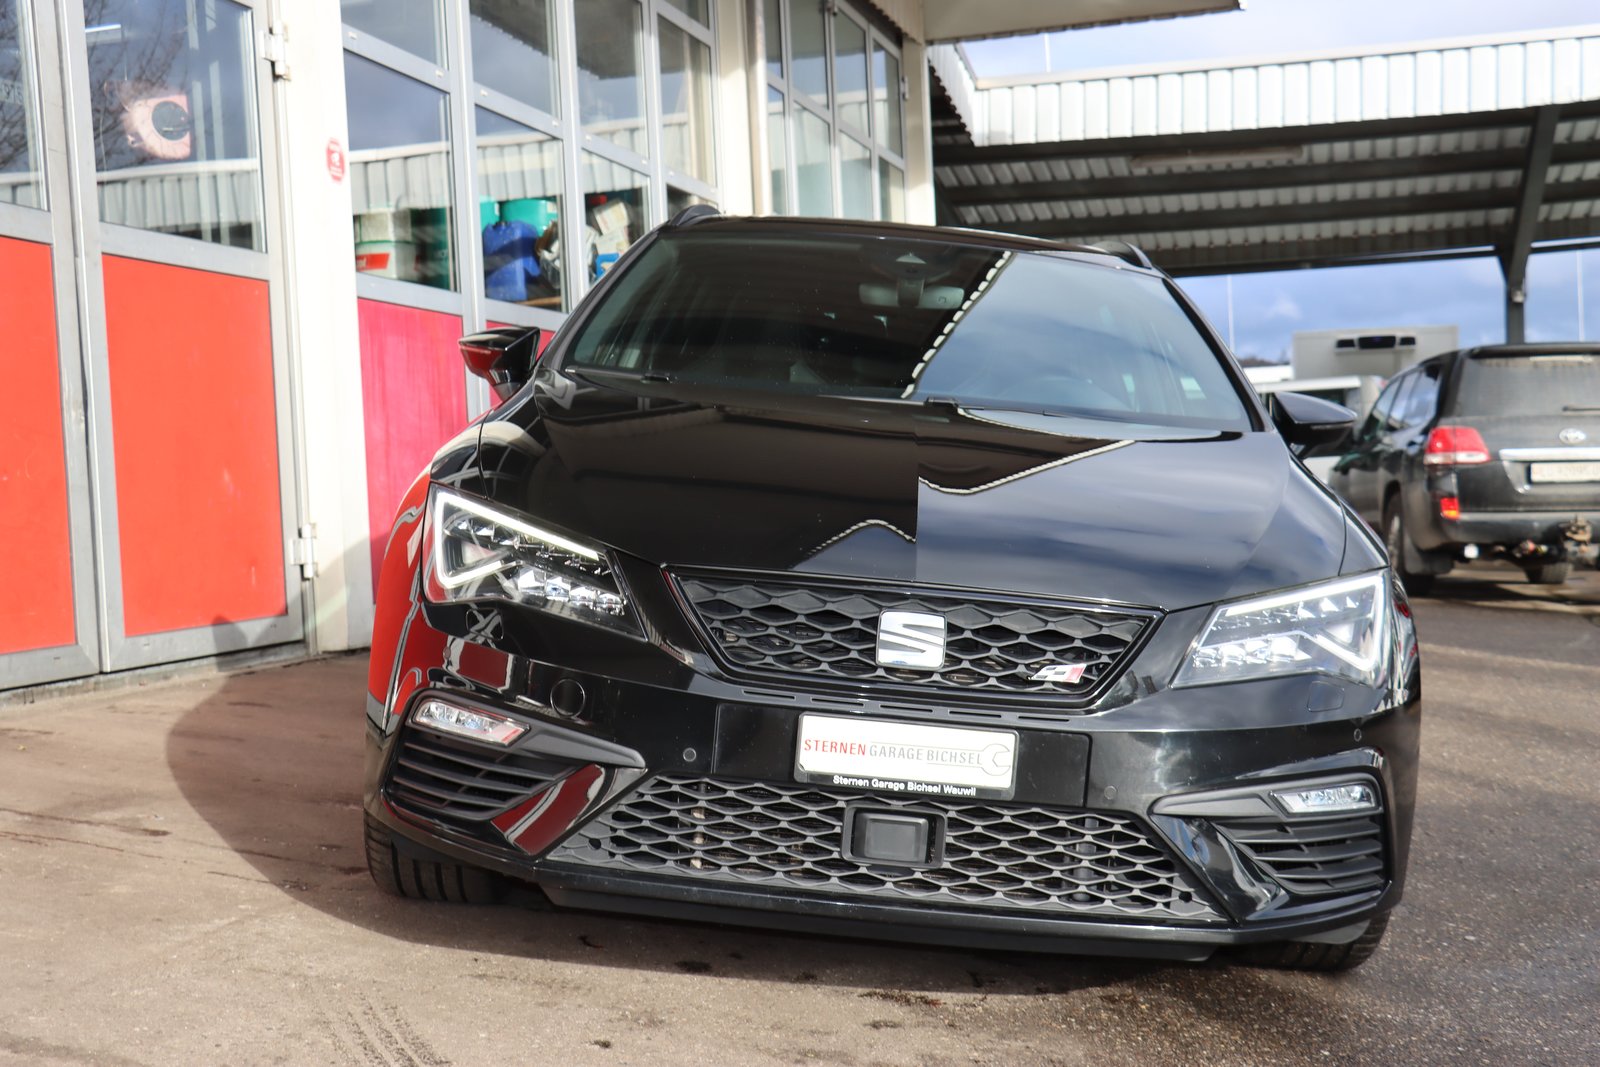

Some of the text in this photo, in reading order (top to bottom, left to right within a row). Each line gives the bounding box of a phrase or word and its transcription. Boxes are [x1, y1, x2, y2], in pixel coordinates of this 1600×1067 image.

[804, 739, 983, 765] STERNEN GARAGE BICHSEL
[832, 774, 976, 796] Sternen Garage Bichsel Wauwil
